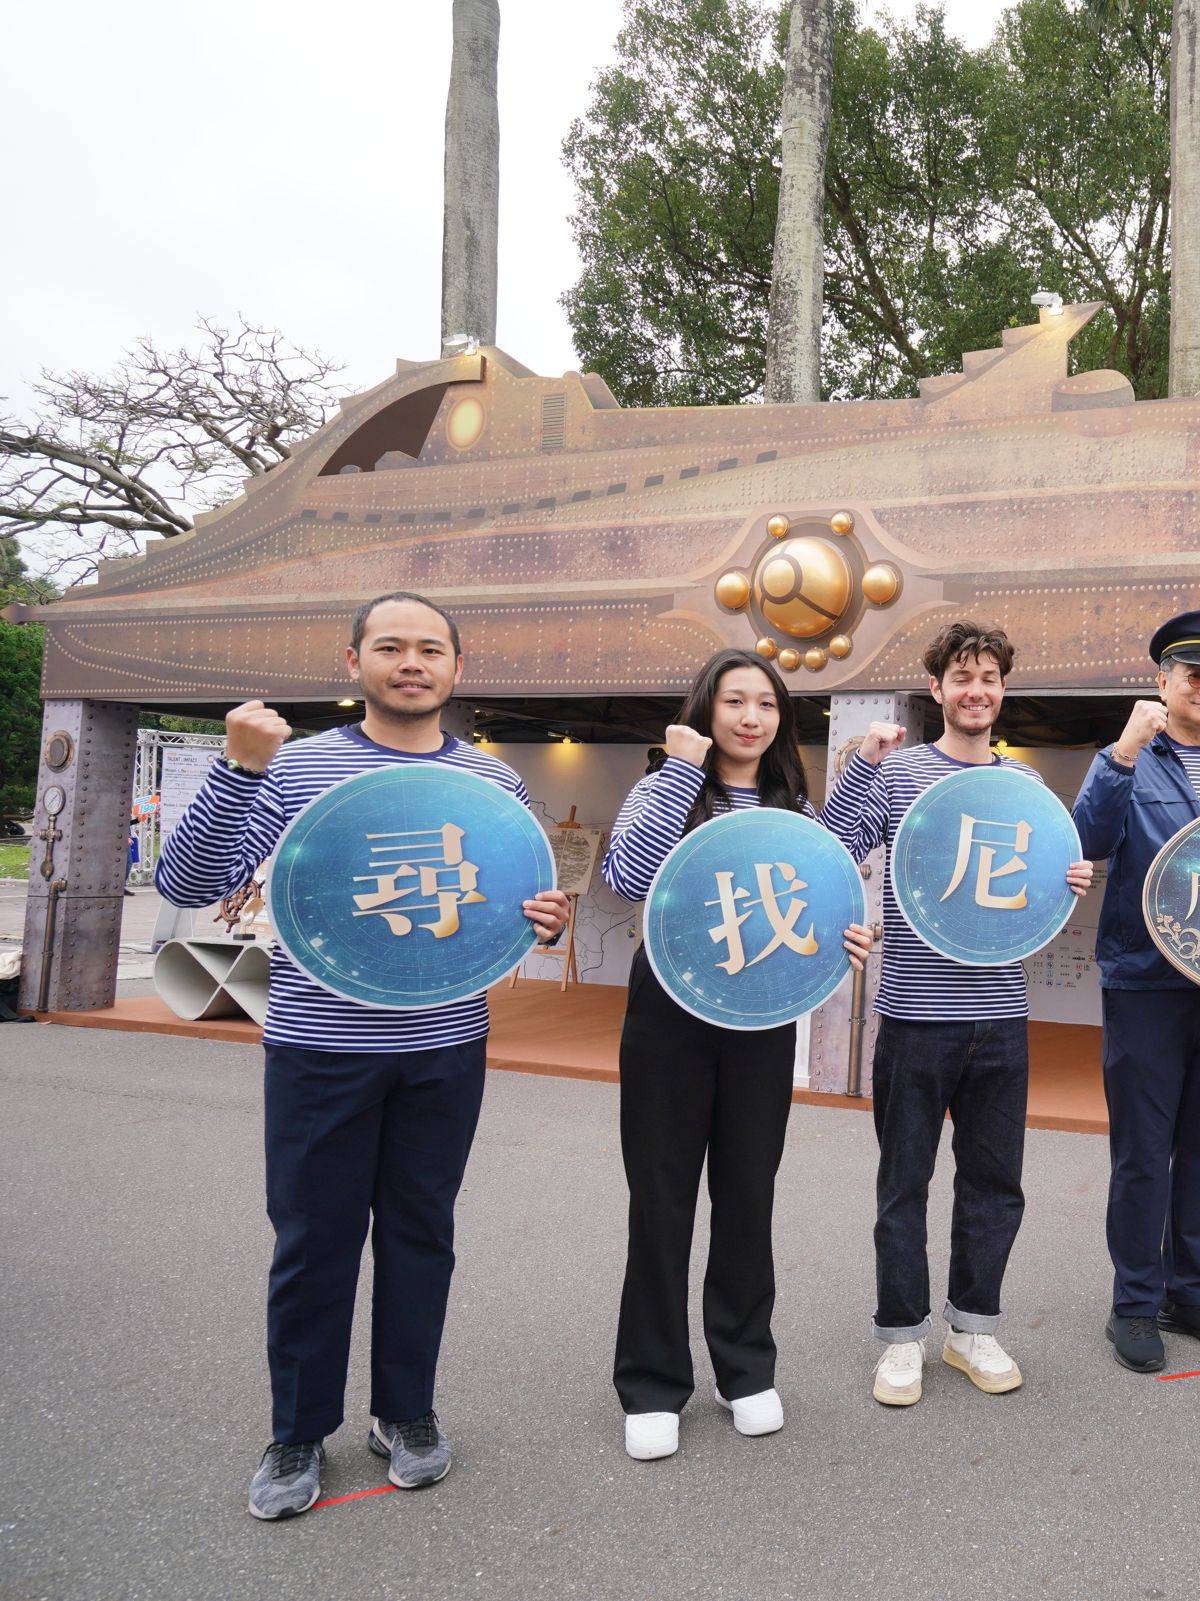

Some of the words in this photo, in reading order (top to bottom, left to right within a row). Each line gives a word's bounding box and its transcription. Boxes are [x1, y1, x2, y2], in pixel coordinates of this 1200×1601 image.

[352, 822, 487, 939] 尋
[939, 812, 1033, 911] 尼
[704, 862, 820, 976] 找
